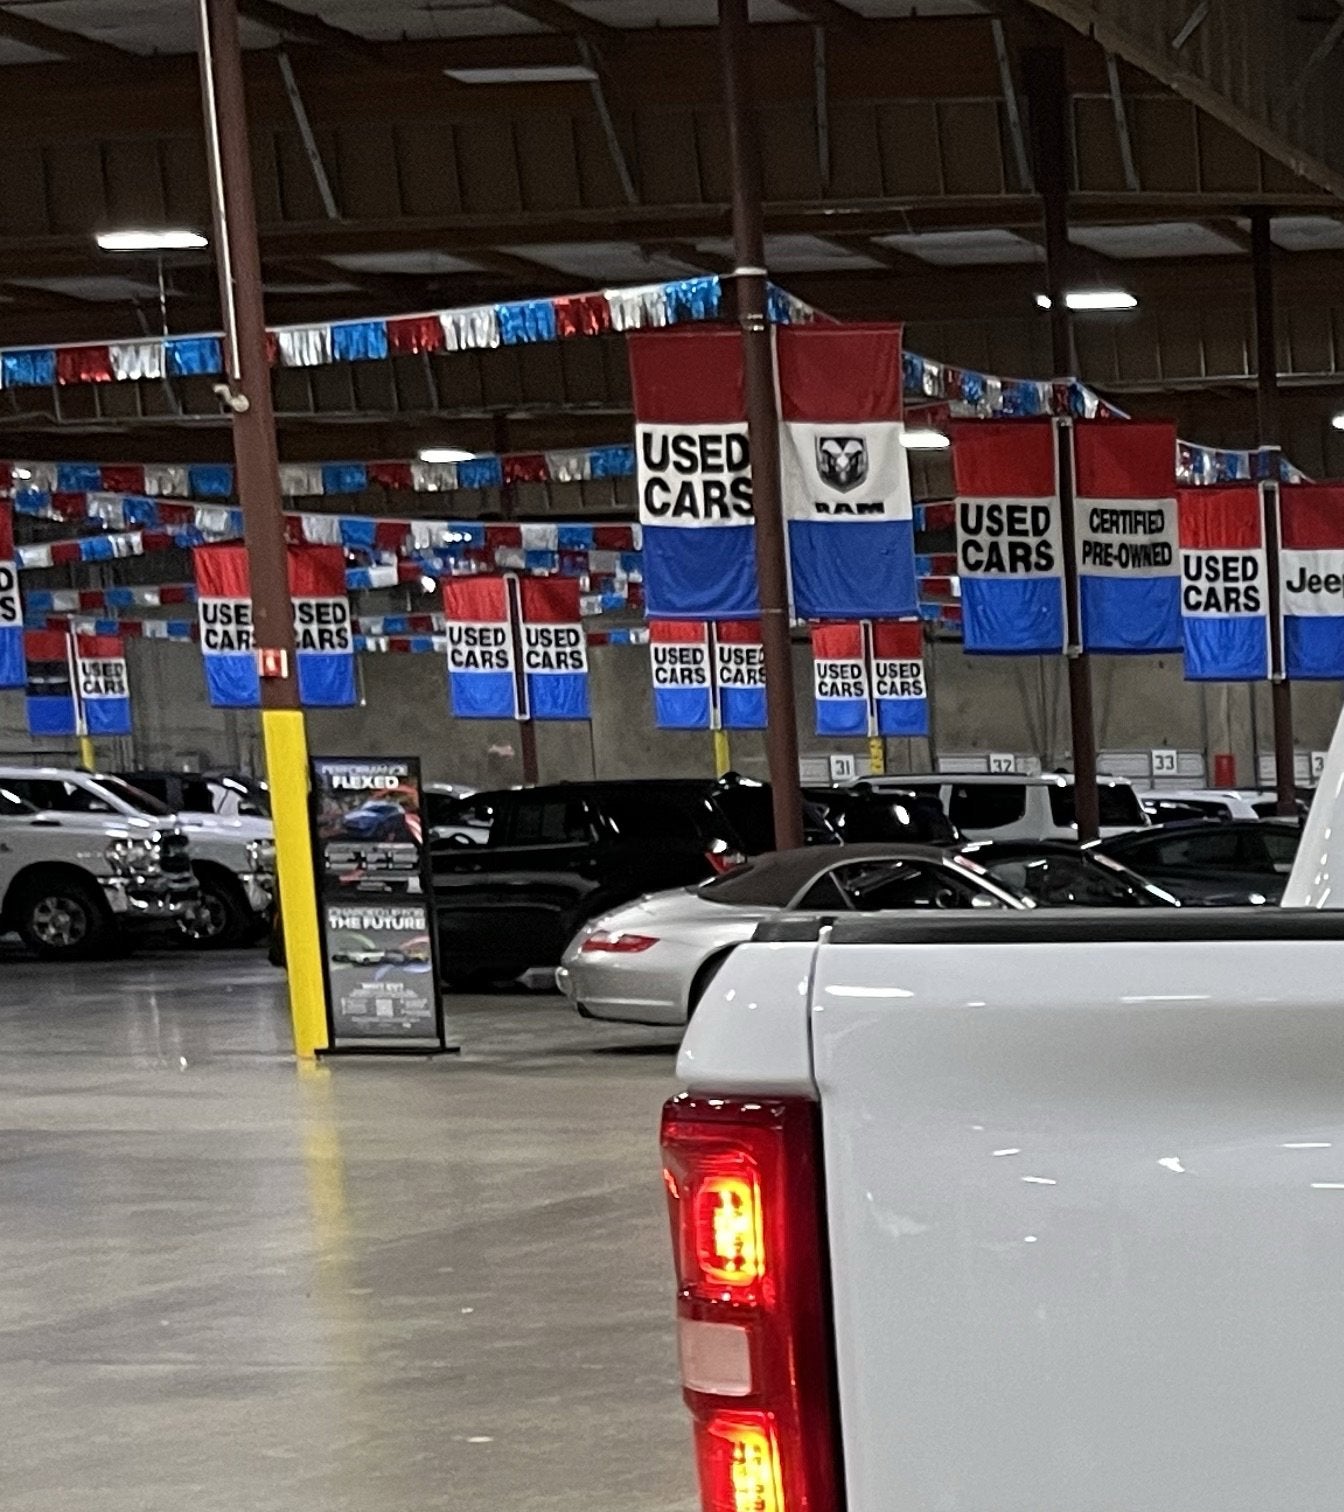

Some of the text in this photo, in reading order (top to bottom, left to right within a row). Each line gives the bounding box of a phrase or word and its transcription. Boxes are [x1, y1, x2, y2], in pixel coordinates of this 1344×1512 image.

[642, 432, 751, 475] USED
[644, 476, 753, 519] CARS
[815, 502, 885, 514] RAM
[960, 502, 1051, 537] USED
[1089, 507, 1165, 535] CERTIFIED
[962, 539, 1055, 573] CARS
[1082, 540, 1172, 568] PRE-OWNED
[1183, 554, 1259, 583] USED
[1183, 585, 1261, 613] CARS
[202, 602, 250, 626] USE
[293, 602, 347, 625] SED
[205, 628, 251, 650] CAR
[297, 628, 349, 650] ARS
[449, 626, 507, 647] USED
[526, 627, 581, 648] USED
[451, 649, 510, 669] CARS
[526, 650, 584, 670] CARS
[654, 647, 705, 666] USED
[82, 662, 124, 677] USED
[655, 667, 707, 685] CARS
[817, 663, 863, 680] USED
[876, 662, 922, 680] USED
[83, 680, 126, 694] CARS
[818, 681, 865, 697] CARS
[876, 680, 924, 696] CARS
[835, 759, 850, 775] 31
[1154, 754, 1175, 770] 33
[331, 775, 399, 789] FLEXED
